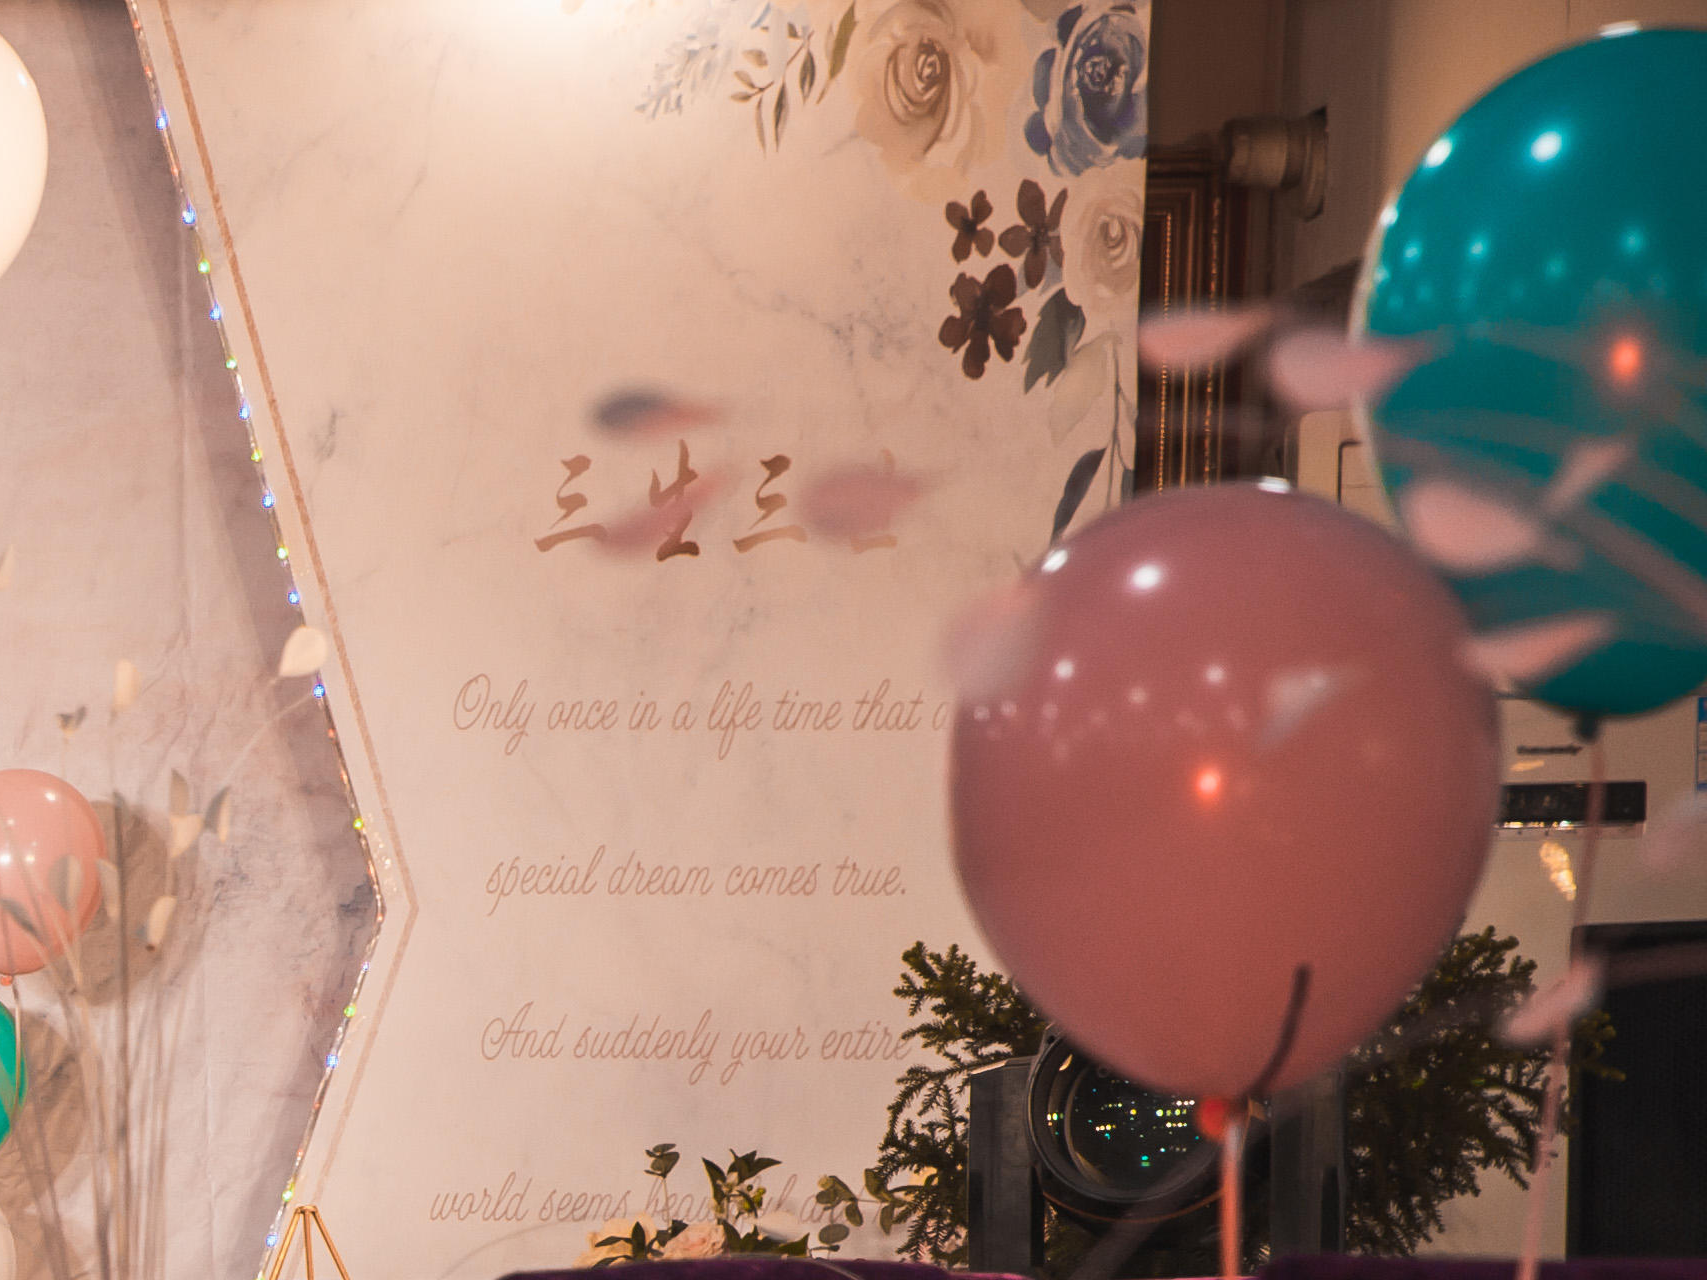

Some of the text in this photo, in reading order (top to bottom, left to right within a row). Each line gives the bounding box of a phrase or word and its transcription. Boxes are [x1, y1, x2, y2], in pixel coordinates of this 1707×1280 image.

[533, 438, 898, 563] 三生三
[453, 673, 535, 756] Only
[548, 697, 619, 731] once
[628, 690, 662, 731] in
[671, 699, 696, 731] a
[707, 680, 762, 760] life
[772, 690, 842, 731] time
[851, 678, 925, 731] that
[486, 845, 906, 917] special dream comes true.
[481, 1001, 913, 1086] And suddenly your entire
[430, 1170, 534, 1222] world
[538, 1188, 633, 1222] seems
